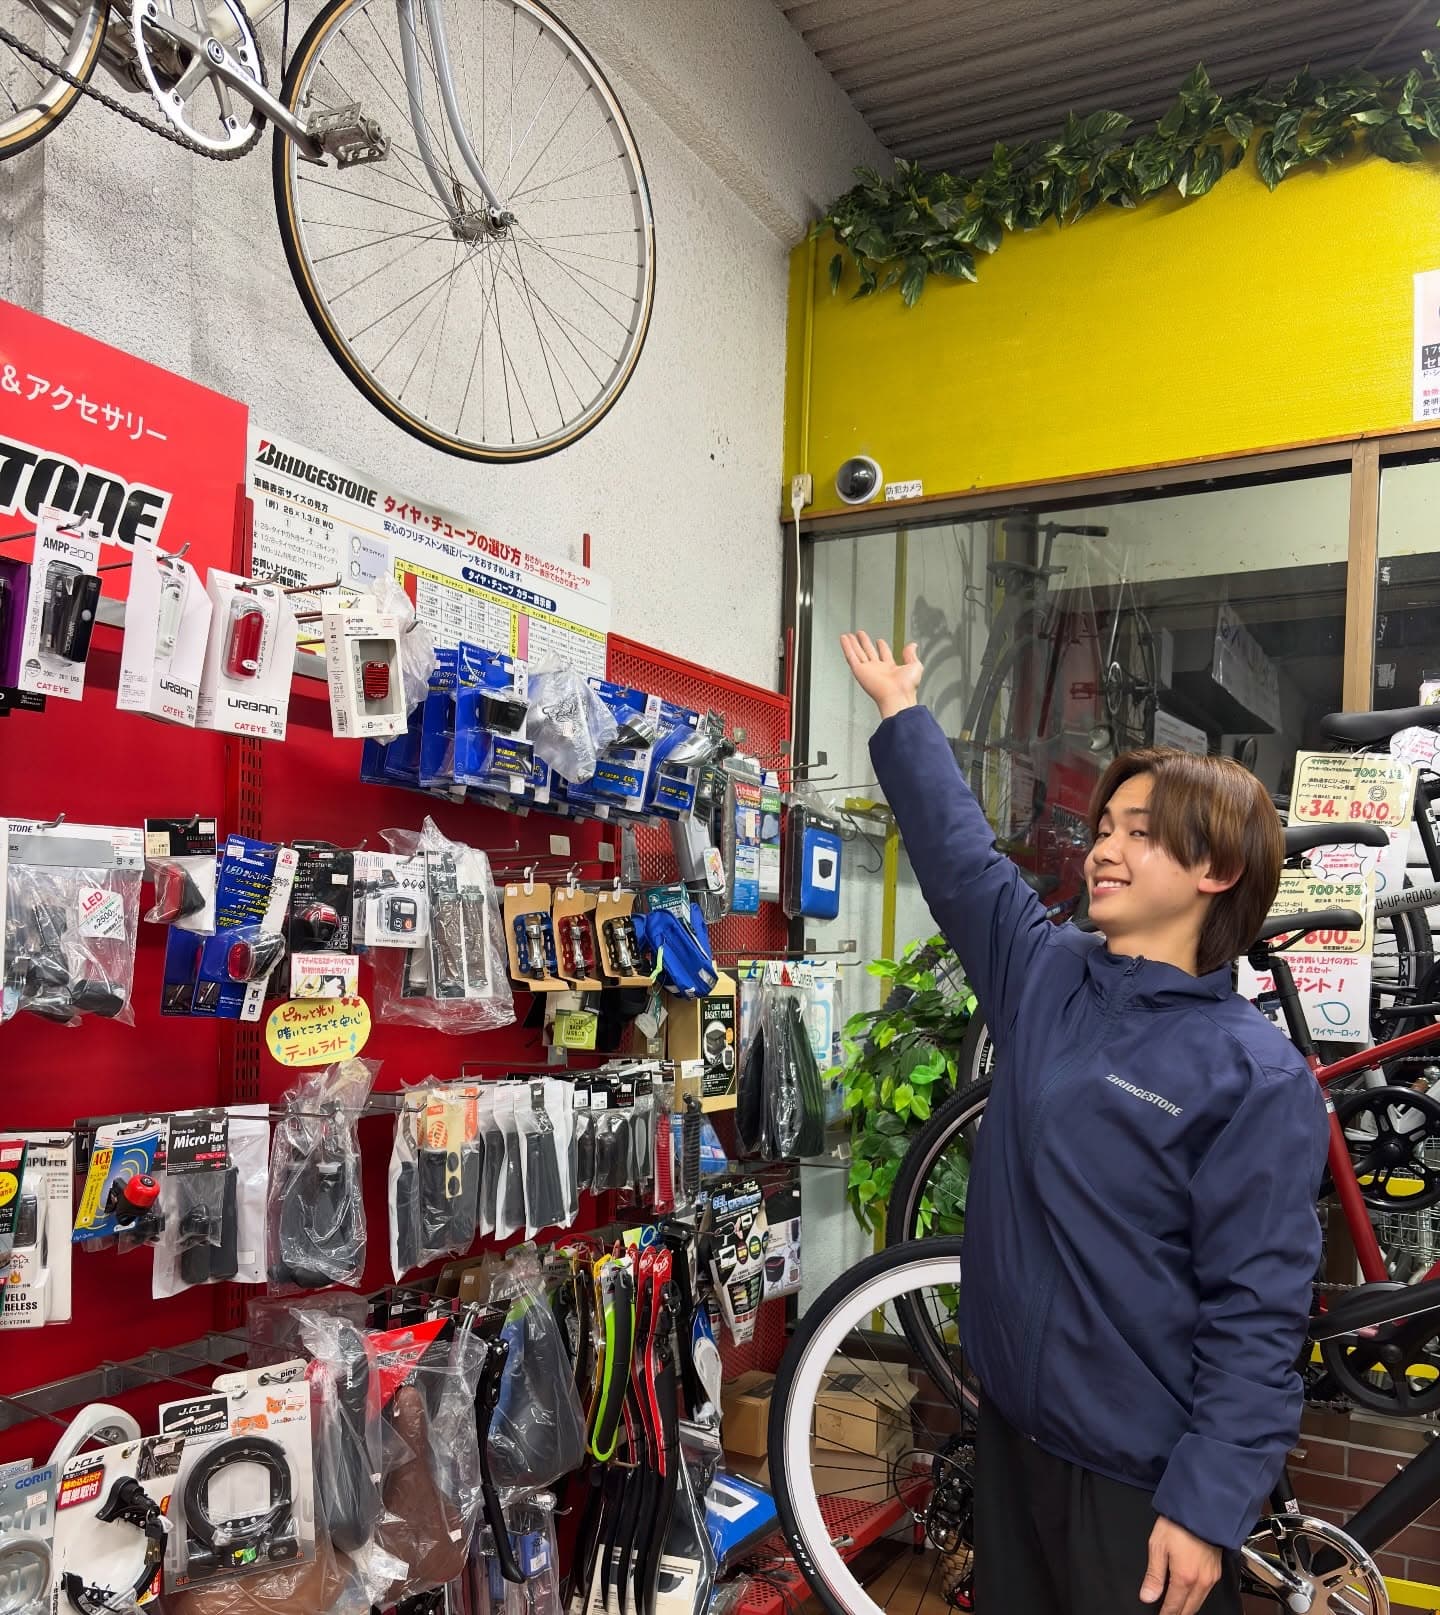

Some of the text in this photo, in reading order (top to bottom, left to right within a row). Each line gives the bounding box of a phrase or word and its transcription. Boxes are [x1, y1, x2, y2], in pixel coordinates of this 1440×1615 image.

[1, 365, 167, 442] &アクセサリー
[255, 439, 378, 507] BRIDGESTONE
[384, 495, 522, 567] タイヤ・チューブの選び方
[36, 681, 72, 695] CATEYE
[160, 678, 193, 700] URBAN
[162, 704, 185, 718] CATEYE
[227, 697, 278, 716] URBAN
[234, 722, 267, 735] CATEYE
[82, 891, 103, 911] LED
[1405, 888, 1433, 903] ROAD
[282, 1005, 335, 1022] ピカッと光り
[1312, 1028, 1361, 1037] ワイヤーロック
[285, 1036, 348, 1061] テールライト
[1104, 1074, 1184, 1117] BRIDGESTONE
[174, 1133, 225, 1150] Micro Flex
[94, 1150, 111, 1166] ACE
[5, 1292, 27, 1301] VELO
[280, 1367, 298, 1380] pine
[15, 1470, 52, 1490] GORIN
